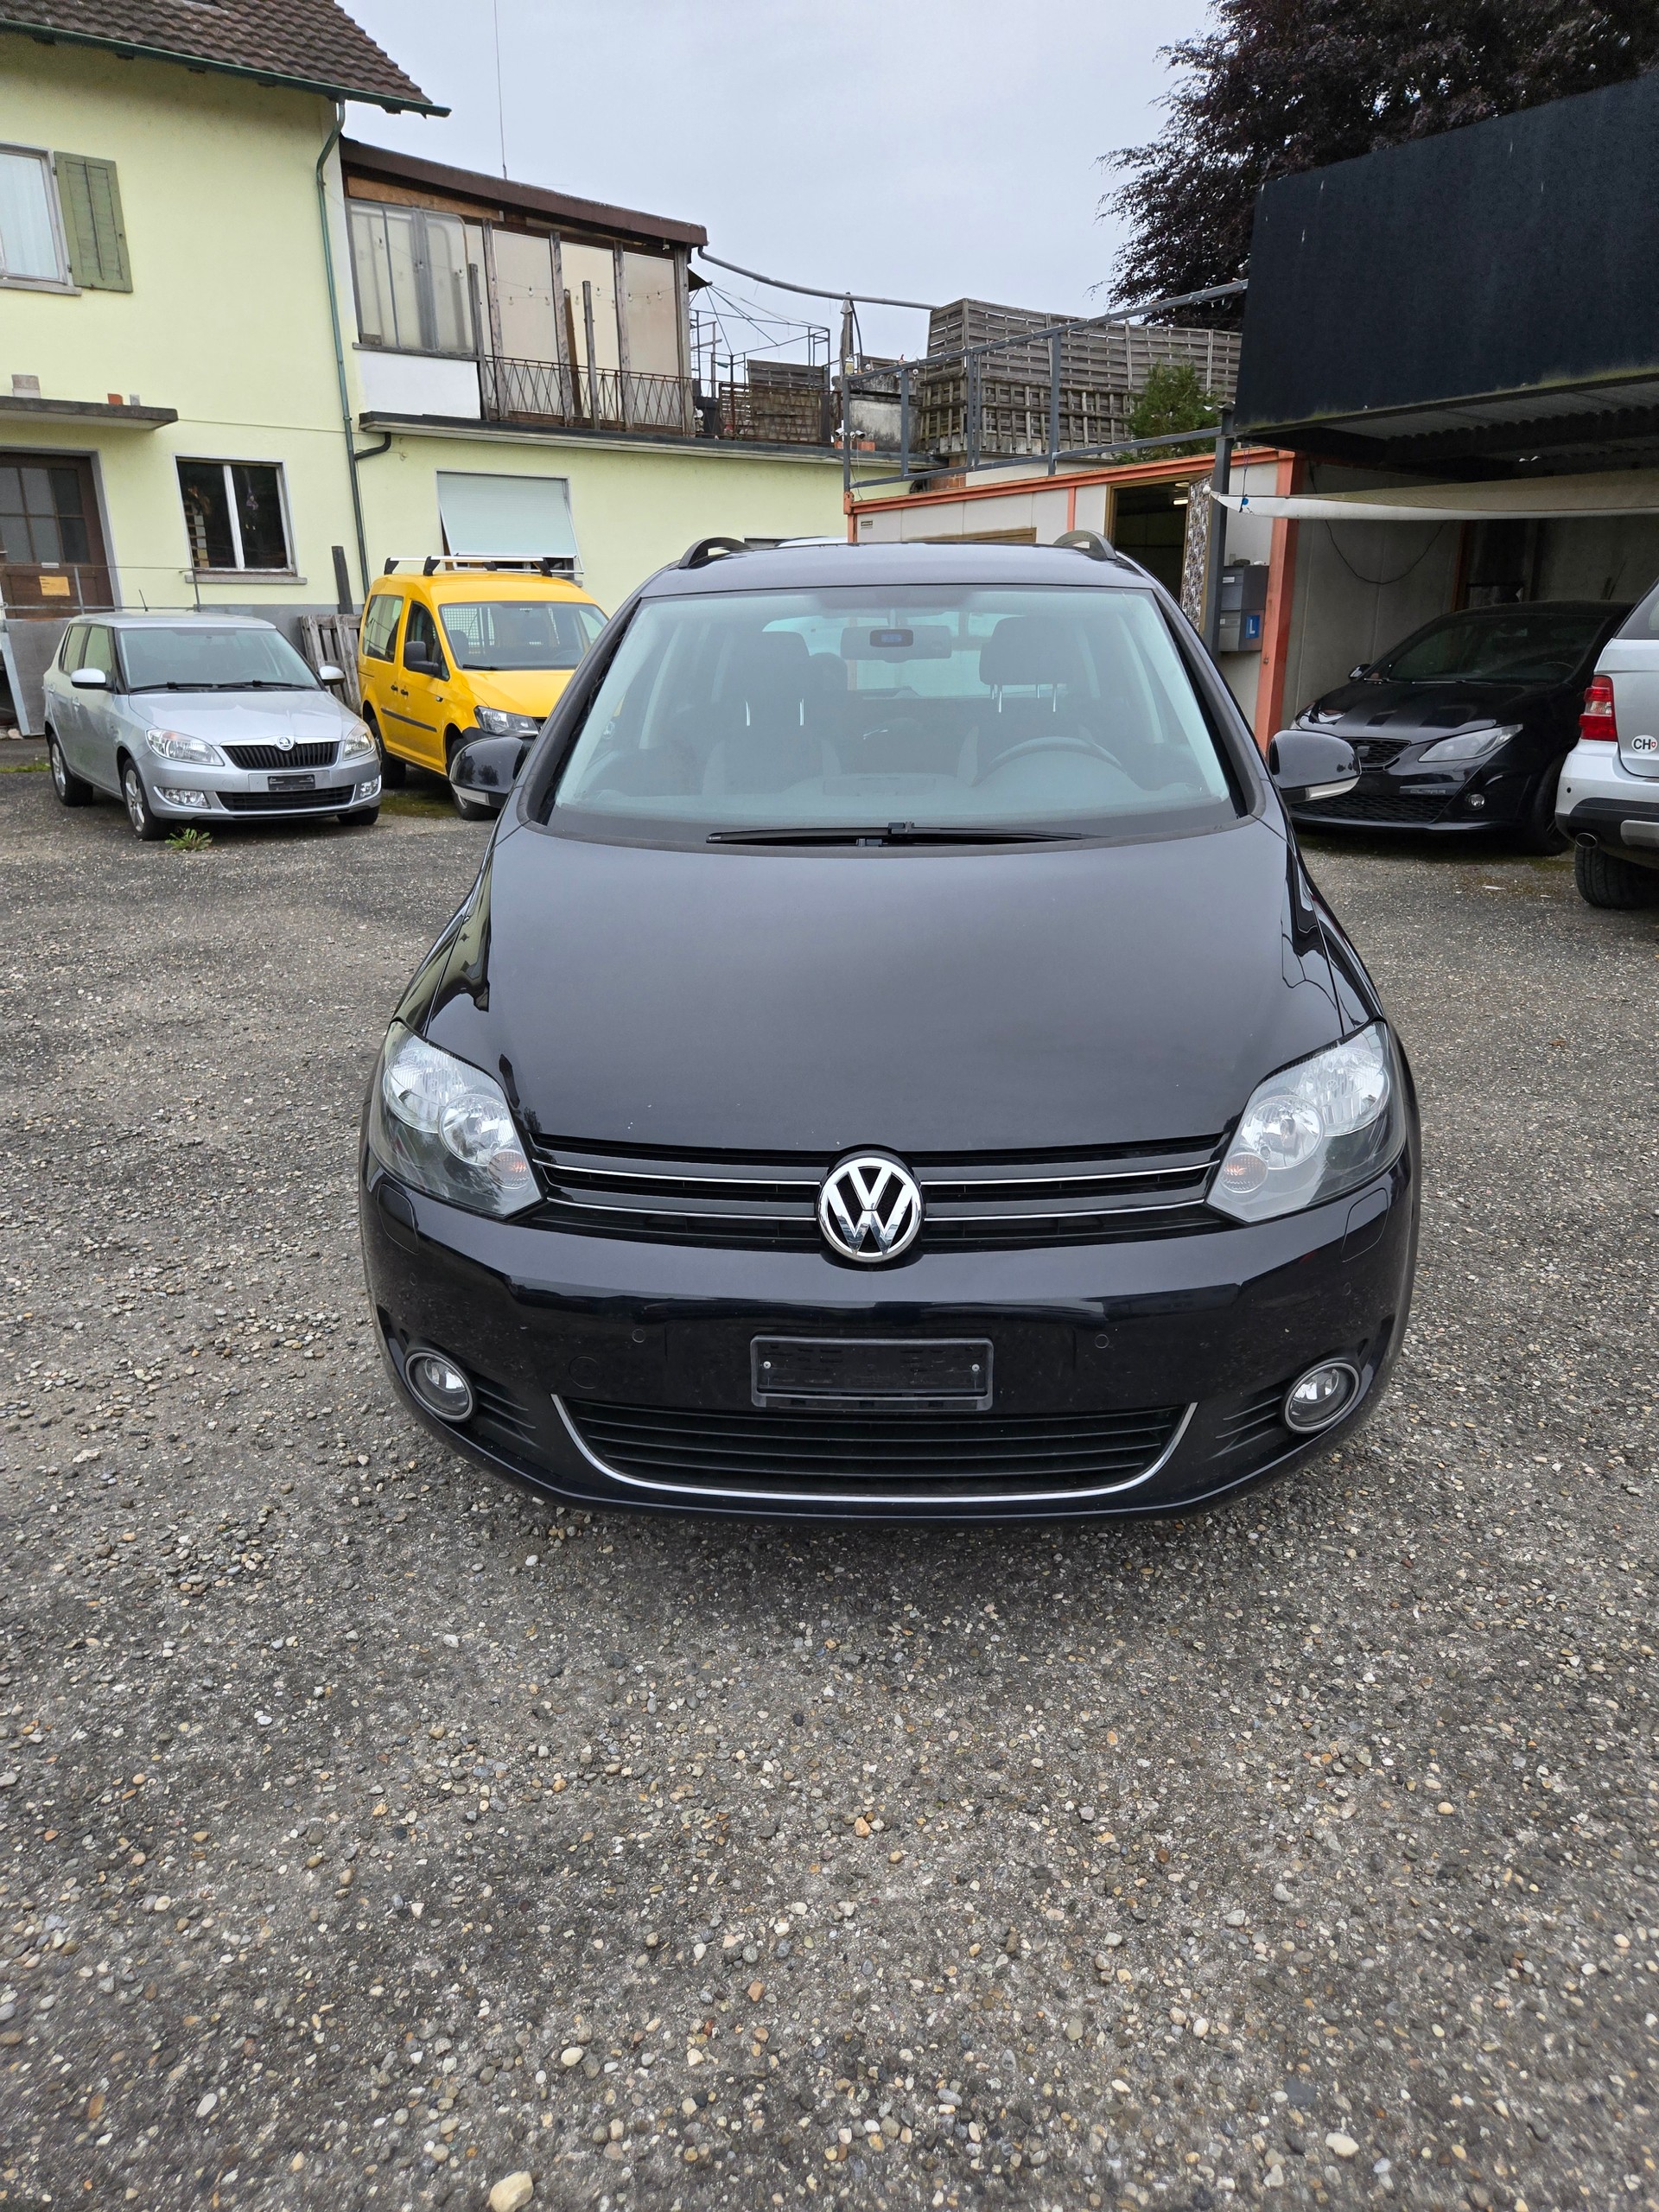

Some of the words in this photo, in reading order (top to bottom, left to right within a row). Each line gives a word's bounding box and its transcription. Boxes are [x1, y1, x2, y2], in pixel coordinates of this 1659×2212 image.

[1249, 619, 1255, 634] L
[1633, 738, 1651, 750] CH
[820, 1159, 920, 1260] VW
